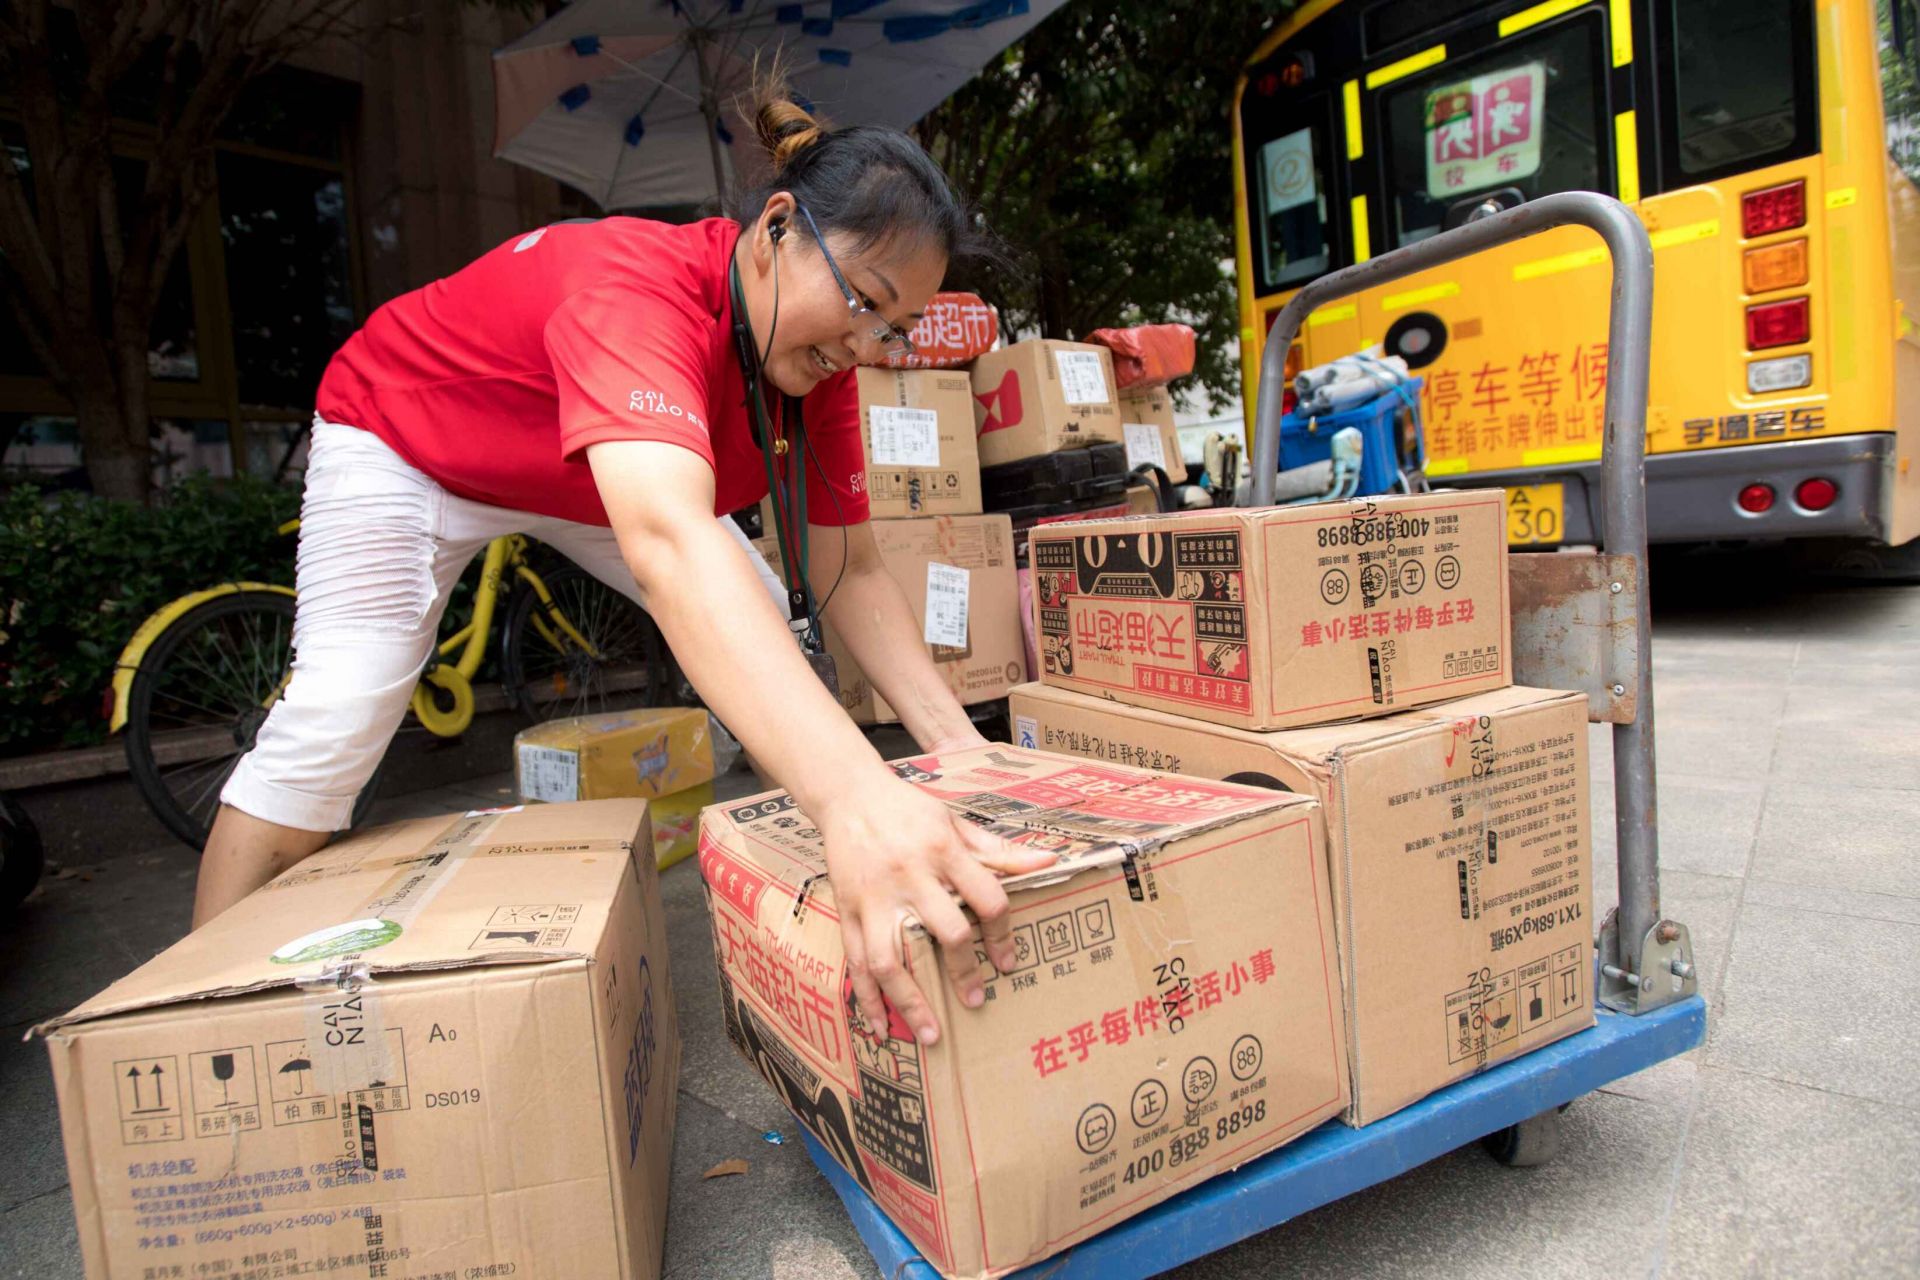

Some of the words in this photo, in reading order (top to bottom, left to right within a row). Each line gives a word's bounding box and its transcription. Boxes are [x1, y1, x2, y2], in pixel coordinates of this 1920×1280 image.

[1423, 343, 1609, 423] 停车等候
[629, 400, 683, 417] NIAO
[1424, 404, 1608, 457] 车指示牌伸出
[1683, 406, 1826, 445] 宇通客车
[1508, 507, 1557, 539] 30
[1326, 578, 1344, 596] 88
[1075, 607, 1186, 660] 天猫超市
[1301, 598, 1475, 649] 在乎每件生活小事
[1079, 649, 1100, 662] MART
[1490, 902, 1583, 952] 1X1.68kgX9瓶
[797, 949, 834, 985] MART
[1053, 961, 1077, 980] 向上
[717, 907, 841, 1063] 天猫超市
[323, 1003, 343, 1047] CAI
[1031, 948, 1277, 1078] 在乎每件生活小事
[1236, 1045, 1256, 1071] 88
[283, 1100, 327, 1120] 怕雨
[425, 1088, 481, 1109] DS019
[132, 1120, 174, 1139] 向上
[200, 1111, 257, 1134] 易碎物品
[1123, 1148, 1164, 1185] 400
[1216, 1099, 1267, 1140] 8898
[128, 1158, 198, 1179] 机洗绝配
[382, 1167, 407, 1182] 袋装
